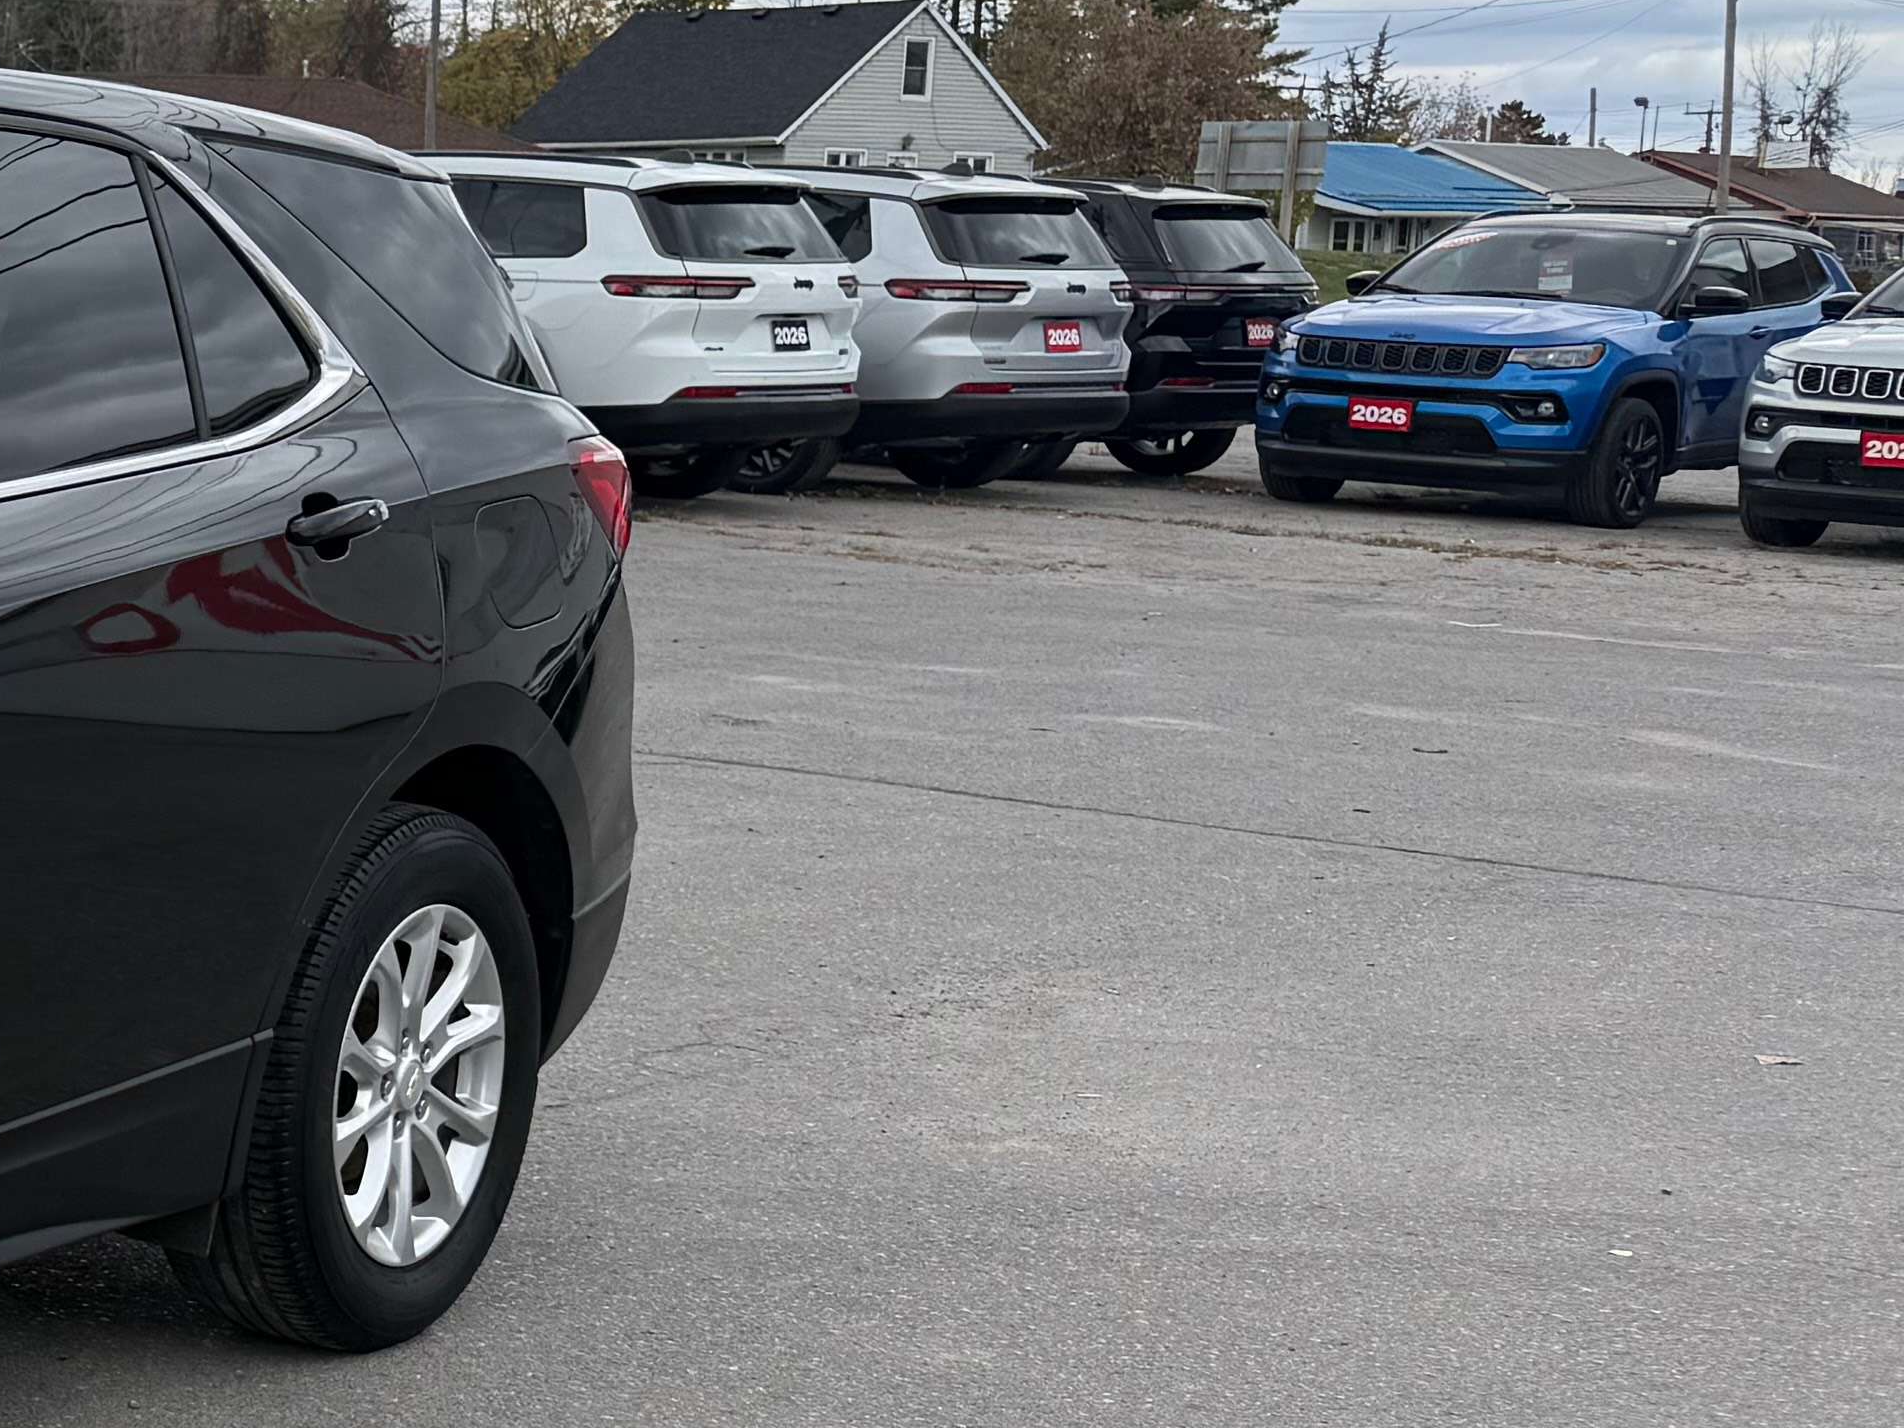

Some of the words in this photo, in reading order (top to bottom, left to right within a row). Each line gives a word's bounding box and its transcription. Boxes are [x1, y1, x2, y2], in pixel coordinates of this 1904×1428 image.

[773, 326, 808, 346] 2026
[1048, 328, 1080, 346] 2026
[1351, 404, 1407, 425] 2026
